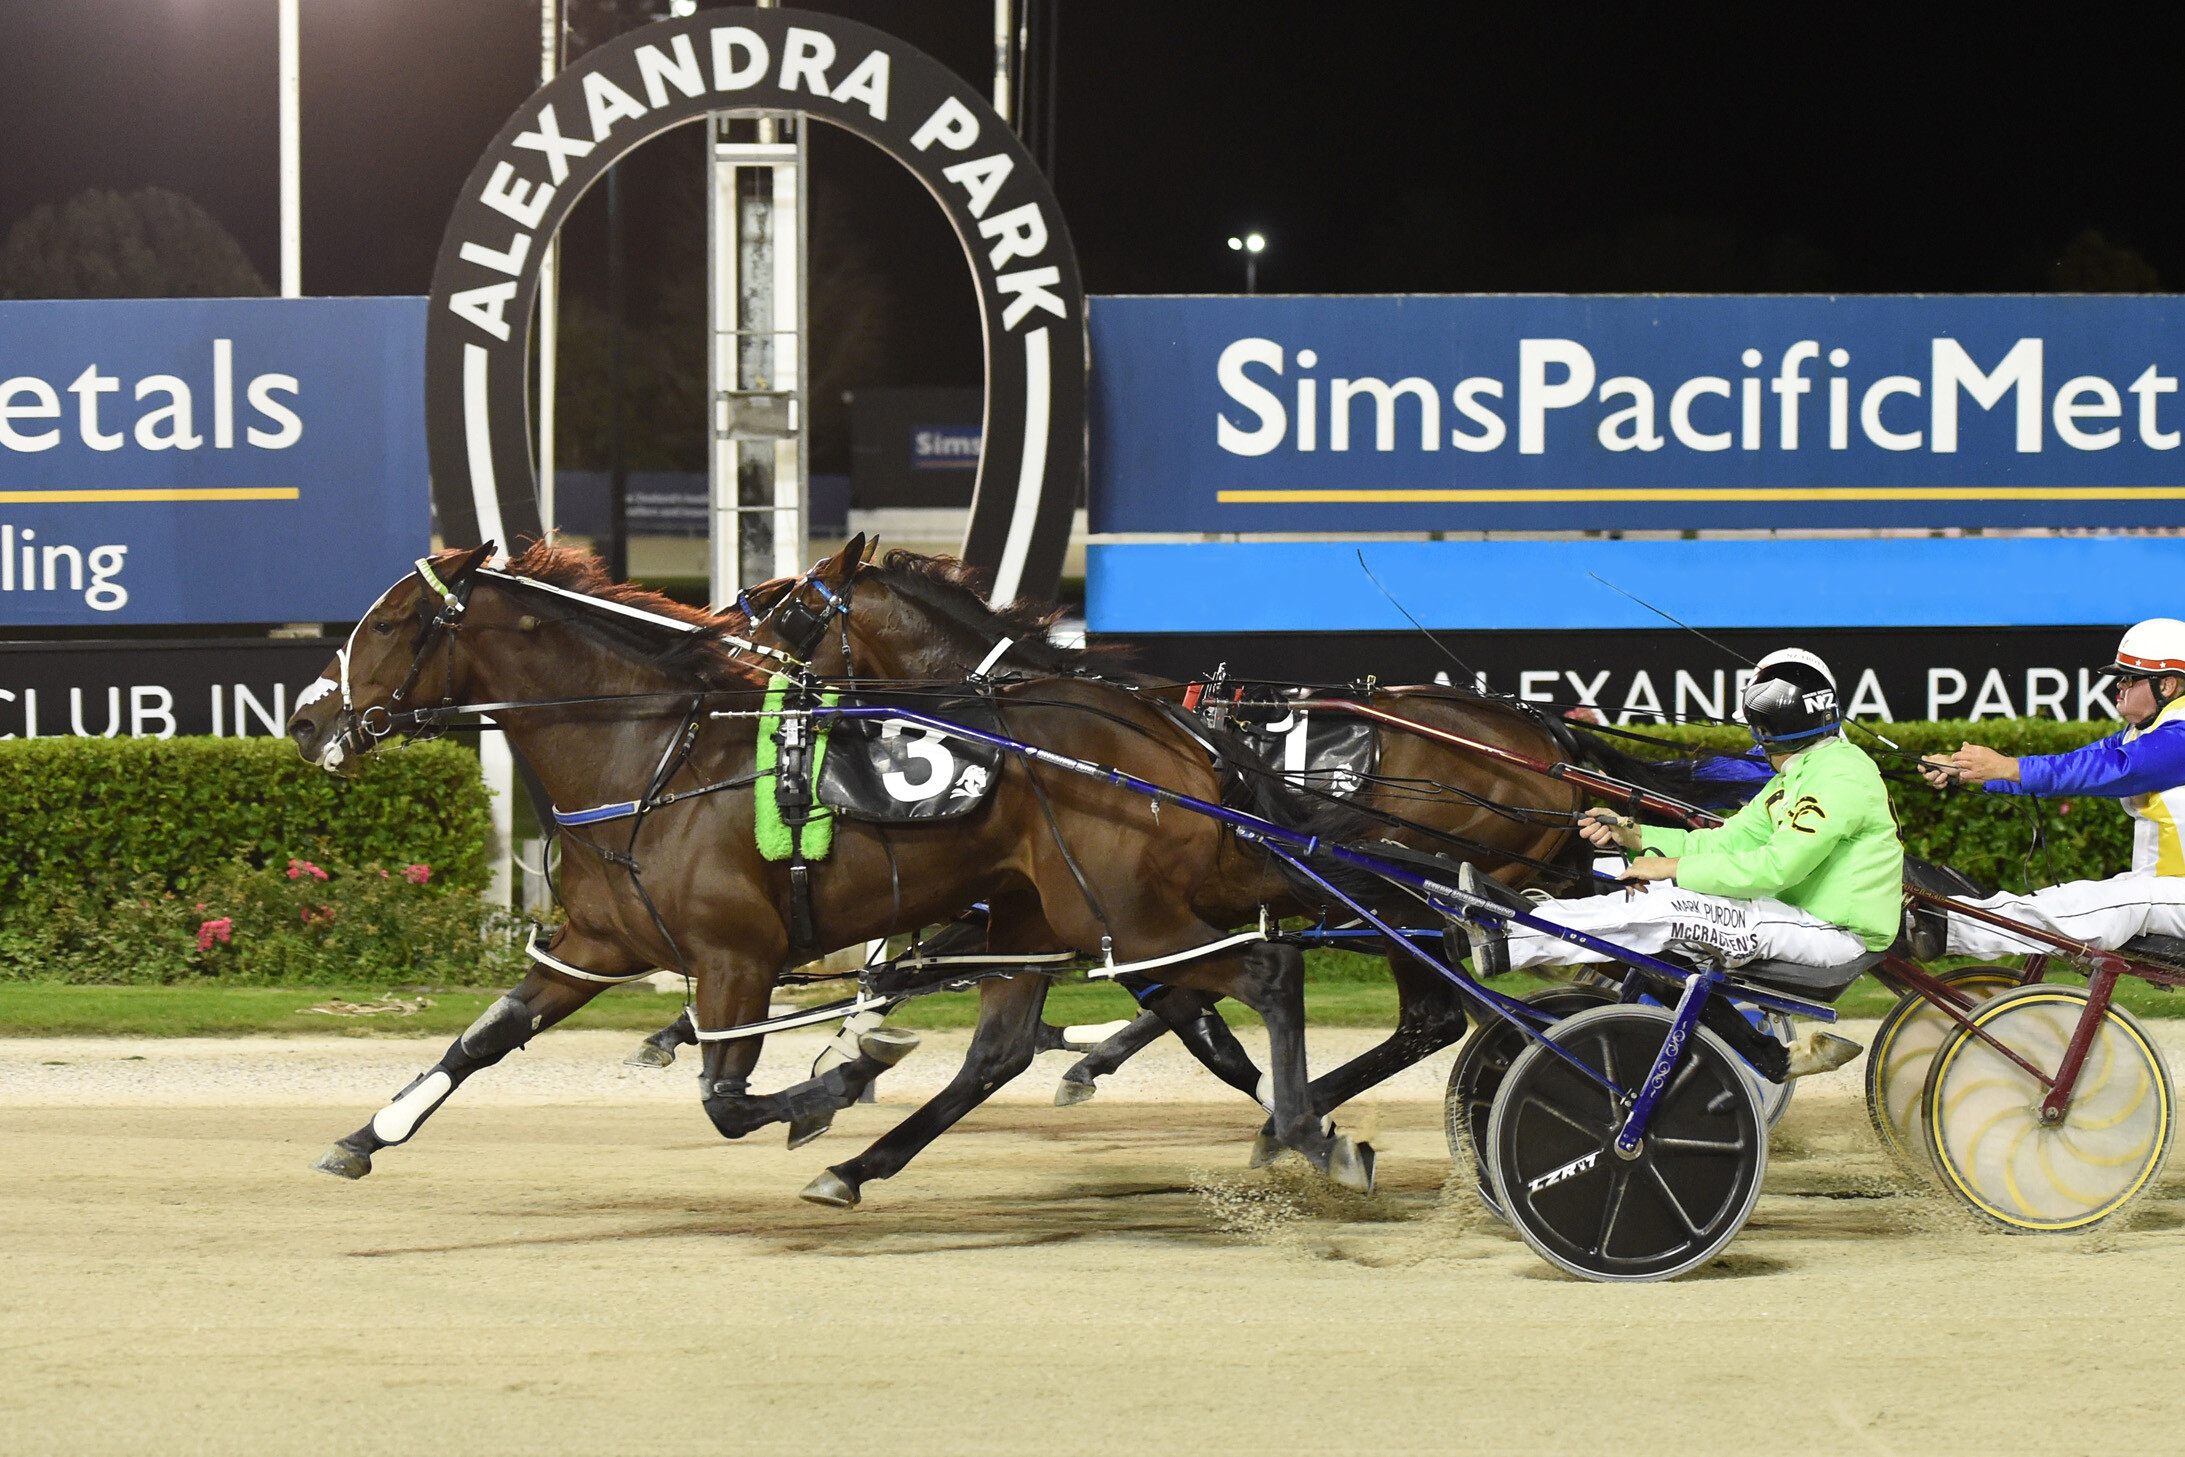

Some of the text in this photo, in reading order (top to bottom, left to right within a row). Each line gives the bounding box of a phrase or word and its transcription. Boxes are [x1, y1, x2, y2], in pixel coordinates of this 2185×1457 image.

[449, 25, 1068, 342] ALEXANDRA PARK
[0, 338, 304, 453] etals
[1216, 336, 2181, 457] SimsPacificMet
[1, 524, 129, 611] ling
[1803, 692, 1837, 715] NZ
[1927, 667, 2123, 724] PARK
[882, 717, 955, 803] 3
[1265, 707, 1310, 790] 1
[1671, 899, 1747, 929] MARK PURDON
